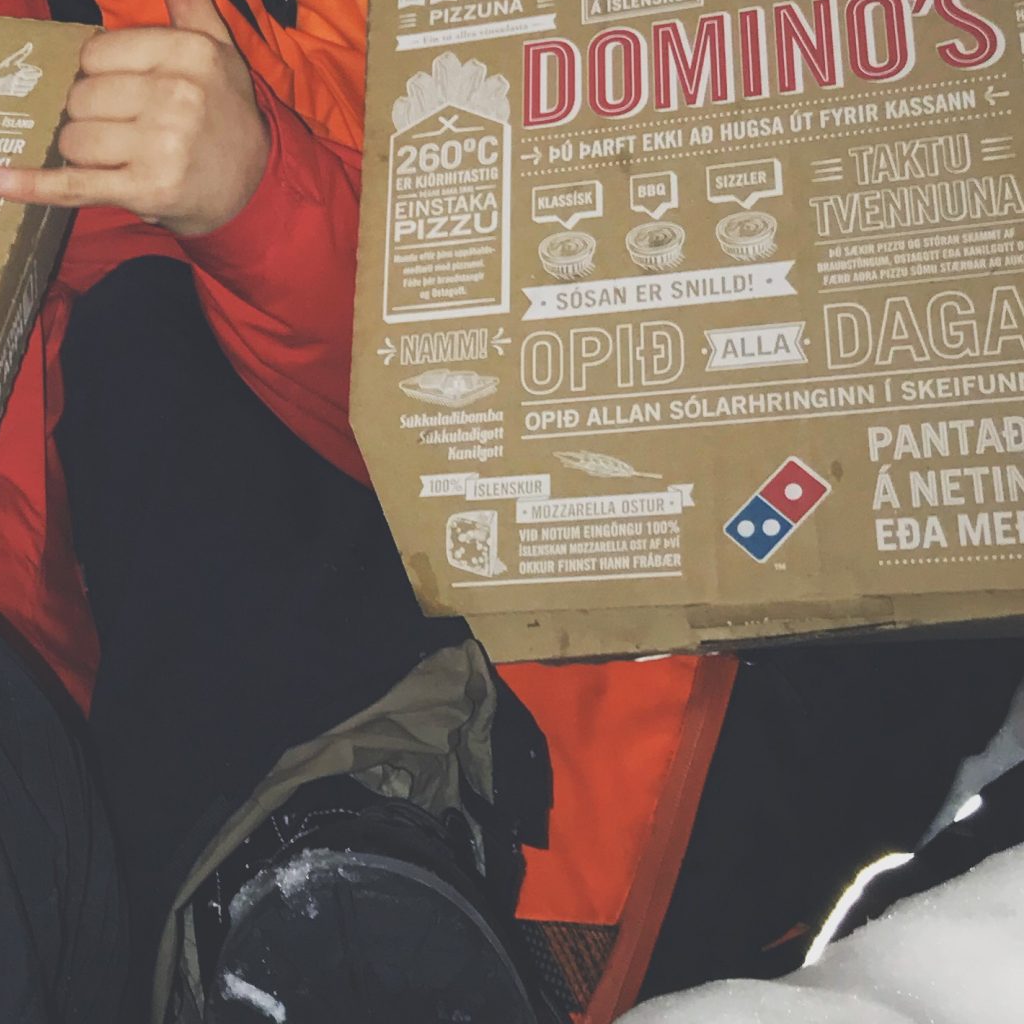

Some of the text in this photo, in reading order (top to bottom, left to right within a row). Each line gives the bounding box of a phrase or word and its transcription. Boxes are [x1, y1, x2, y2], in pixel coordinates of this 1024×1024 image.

[549, 90, 975, 163] ÞÚ ÞARFT EKKI AÐ HUGSA ÚT FYRIR KASSANN
[396, 135, 498, 174] 260°C
[848, 134, 970, 184] TAKTU
[395, 177, 411, 191] ER
[637, 182, 666, 198] BBQ
[715, 170, 766, 189] SIZZLER
[394, 192, 497, 219] EINSTAKA
[538, 191, 592, 209] KLASSÍSK
[810, 175, 1023, 235] TVENNUNA
[393, 210, 497, 241] PIZZU
[876, 239, 905, 252] PIZZU
[922, 234, 960, 247] STÓRAN
[556, 273, 753, 310] SÓSAN ER SNILLD!
[823, 285, 1024, 369] DAGA
[399, 328, 488, 365] NAMM!
[520, 320, 684, 394] OPIÐ
[721, 333, 790, 358] ALLA
[524, 408, 579, 430] OPIÐ
[587, 402, 660, 425] ALLAN
[670, 385, 874, 419] SÓLARHRINGINN
[884, 378, 891, 402] Í
[400, 408, 503, 428] Súkkulaðibomba
[419, 426, 503, 444] Súkkulaðigott
[448, 444, 503, 462] Kanilgott
[429, 478, 462, 493] 100%
[473, 479, 542, 497] ÍSLENSKUR
[872, 463, 900, 510] Á
[531, 497, 664, 519] MOZZARELLA OSTUR
[519, 519, 680, 542] VIÐ NOTUM EINGÖNGU 100%
[875, 515, 947, 550] EÐA
[519, 534, 680, 556] ÍSLENSKAN MOZZARELLA OST AF ÞVÍ
[519, 551, 681, 574] OKKUR FINNST HANN FRÁBÆR
